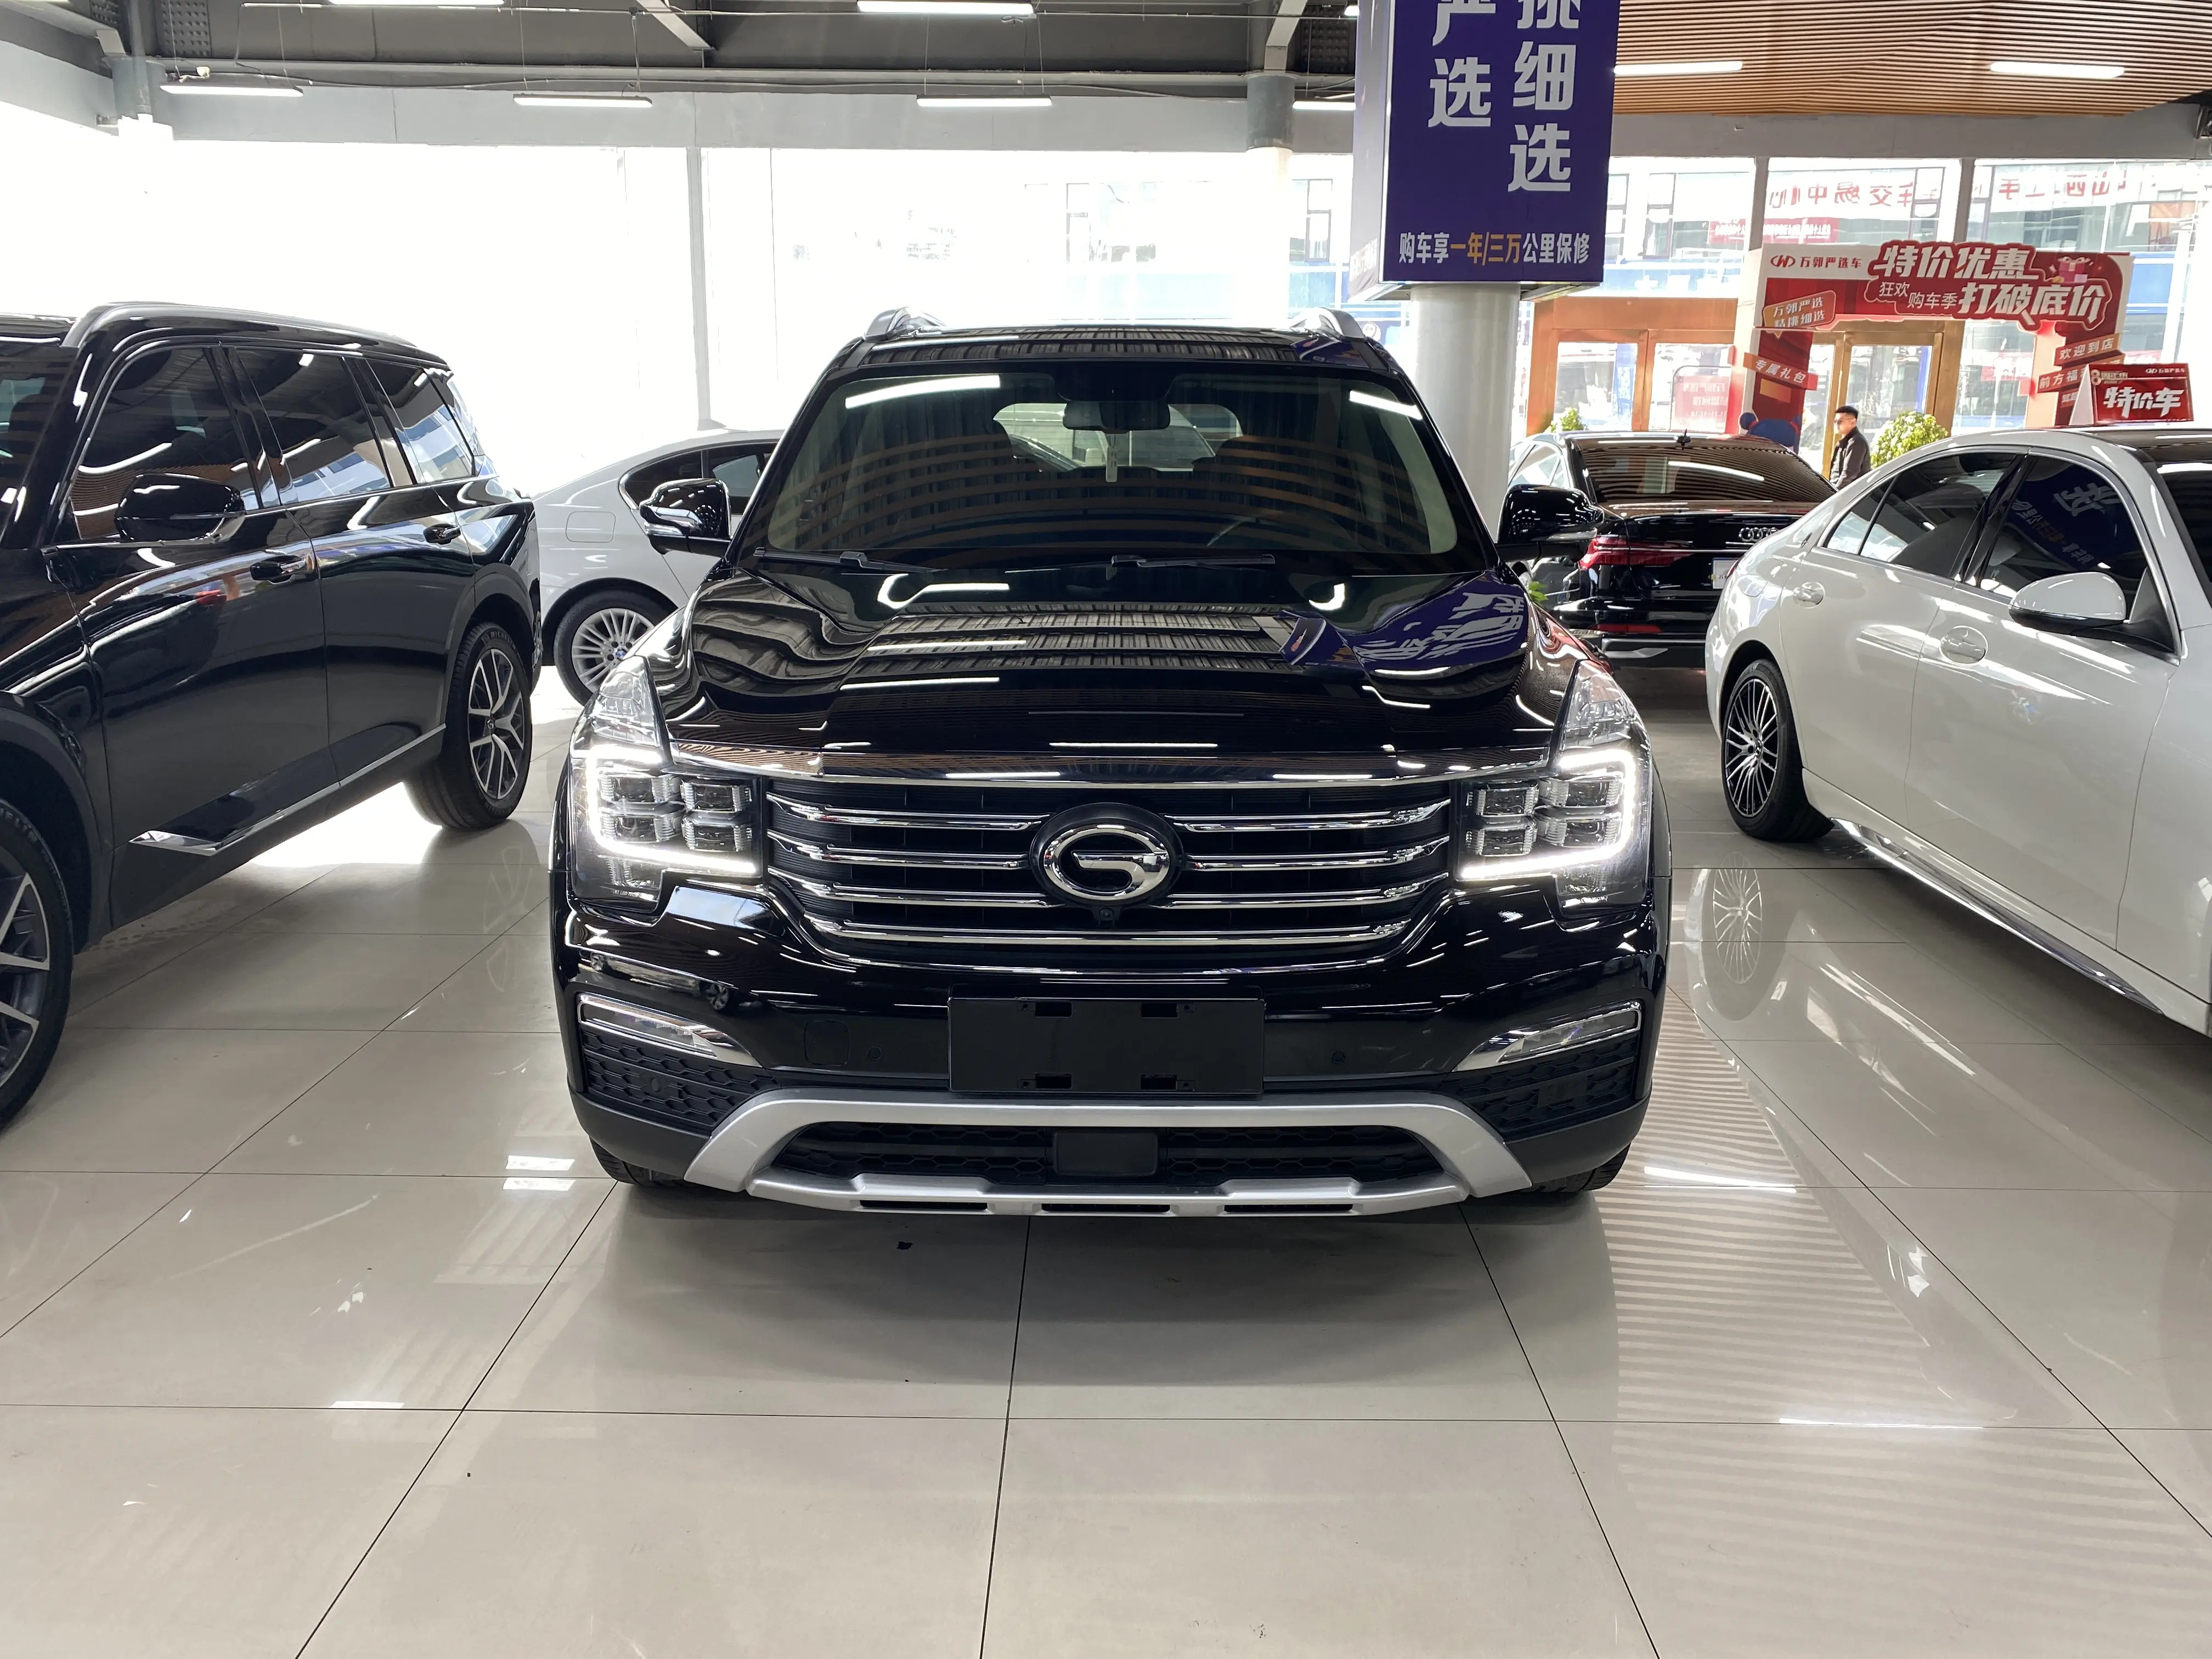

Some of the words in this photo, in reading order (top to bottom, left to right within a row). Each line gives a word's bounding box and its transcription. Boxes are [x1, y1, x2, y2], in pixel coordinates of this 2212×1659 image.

[1398, 232, 1590, 266] 购车享一年/三万公里保修
[1799, 256, 1863, 269] 万郭严选车
[1874, 245, 2039, 280] 特价优惠
[1773, 297, 1824, 318] 万郭严选
[1879, 281, 1910, 298] 狂欢
[1908, 291, 1959, 309] 购车季
[1958, 281, 2106, 325] 打破底价
[2059, 337, 2114, 360] 欢迎到店
[1756, 359, 1807, 383] 专属礼包
[2102, 386, 2185, 419] 特价车
